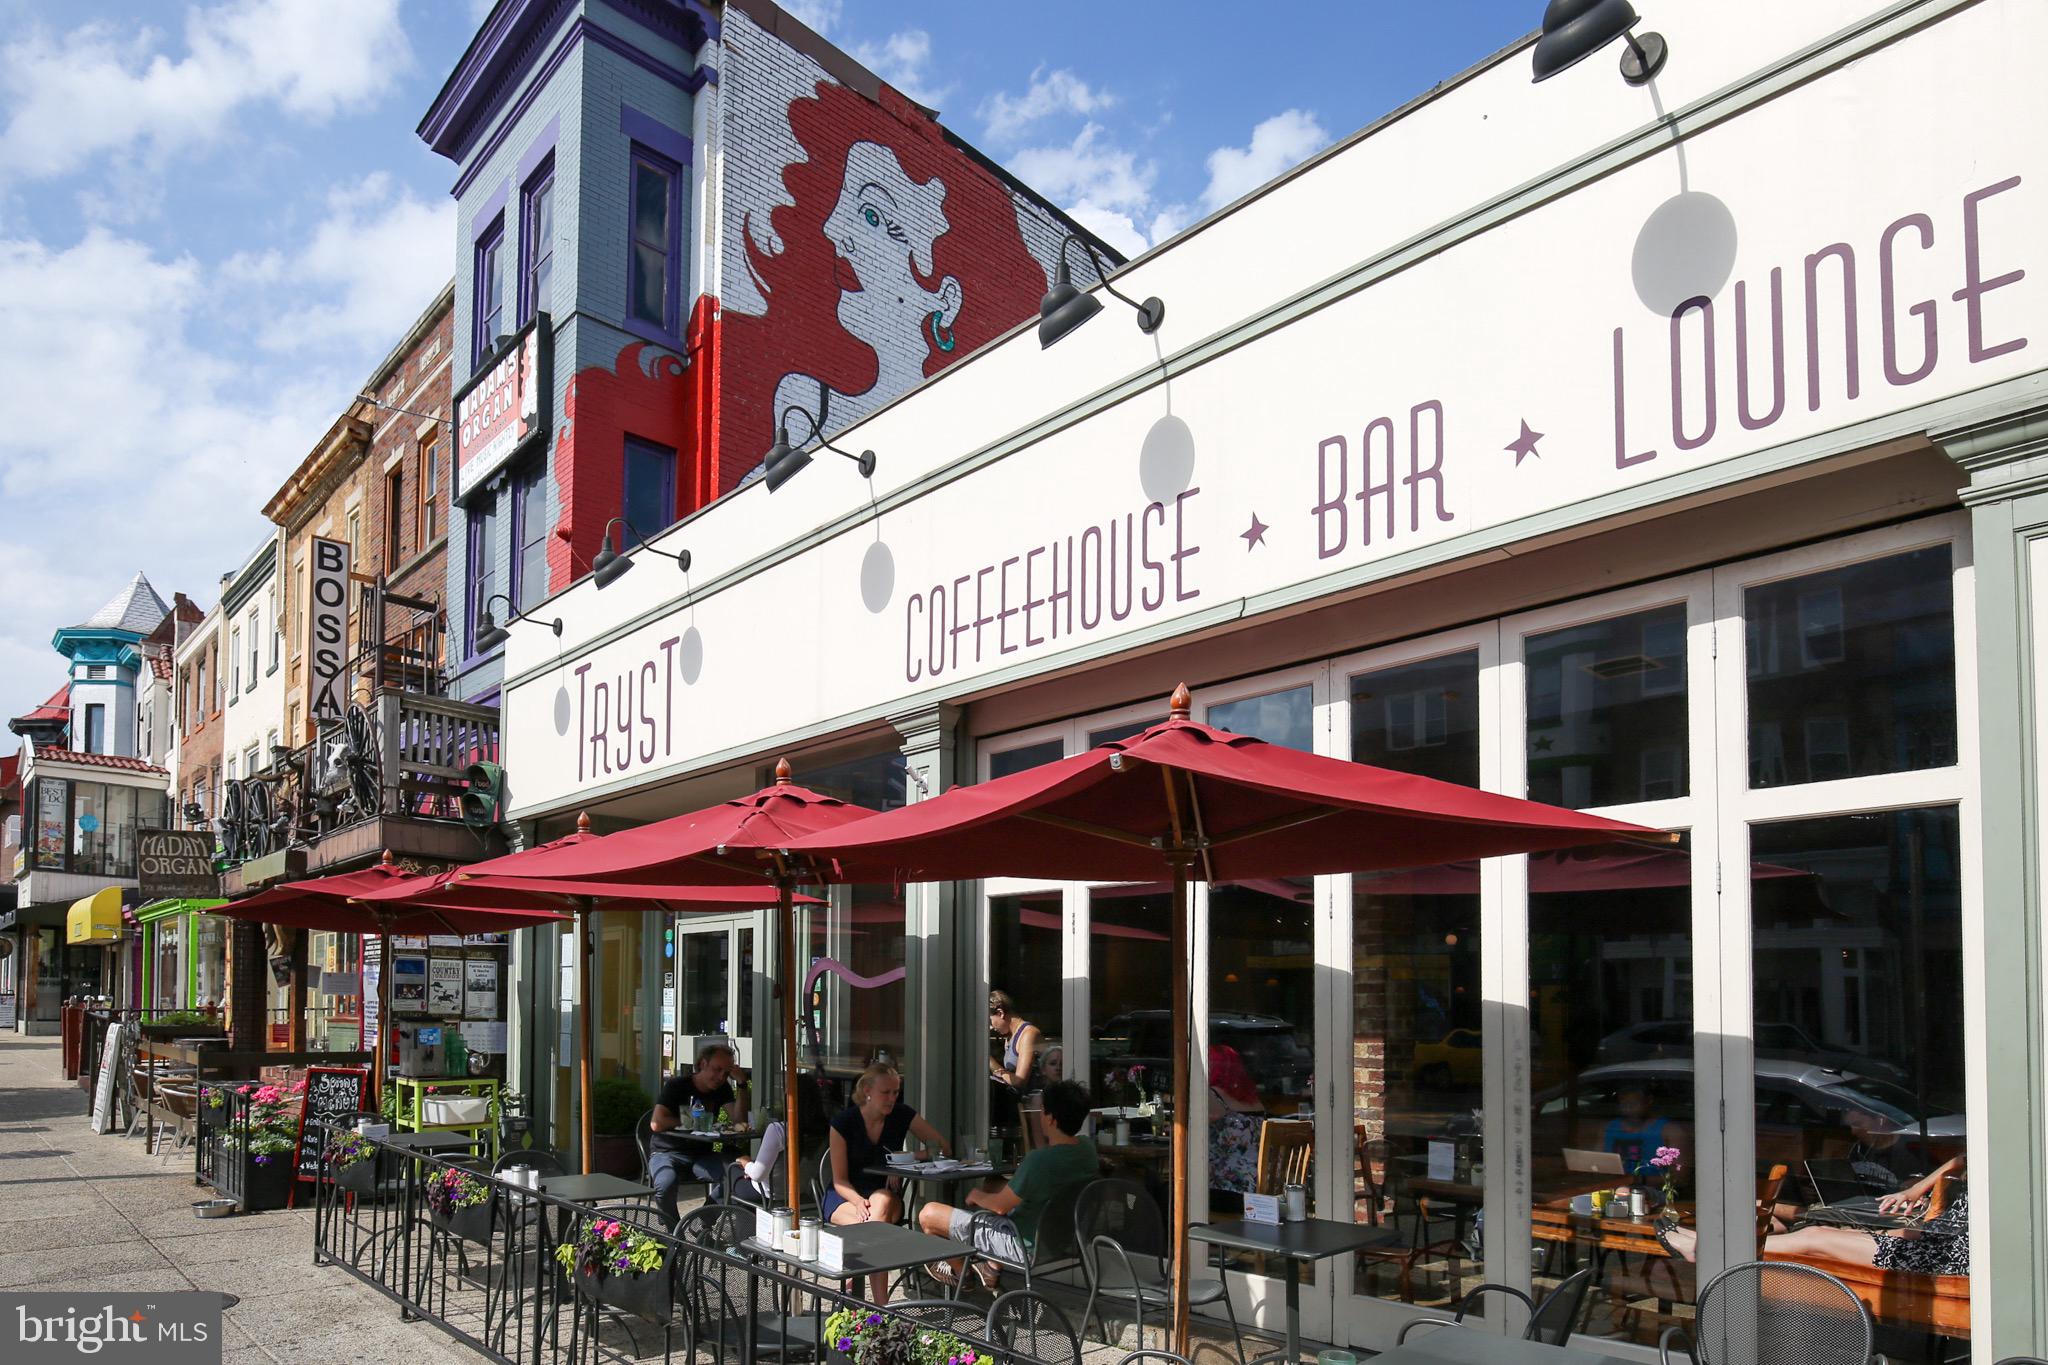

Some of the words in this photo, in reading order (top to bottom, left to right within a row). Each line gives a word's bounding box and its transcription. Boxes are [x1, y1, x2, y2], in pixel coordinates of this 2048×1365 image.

[462, 381, 513, 448] ORGAN
[574, 636, 680, 782] TRYST
[906, 487, 1200, 682] COFFEEHOUSE
[1311, 399, 1454, 560] BAR
[1613, 175, 2028, 470] LOUNGE
[312, 541, 345, 716] BOSSA
[41, 787, 65, 796] BEST
[141, 857, 213, 875] ORGAN
[432, 966, 461, 975] COUNTRY
[318, 1074, 358, 1096] Spring
